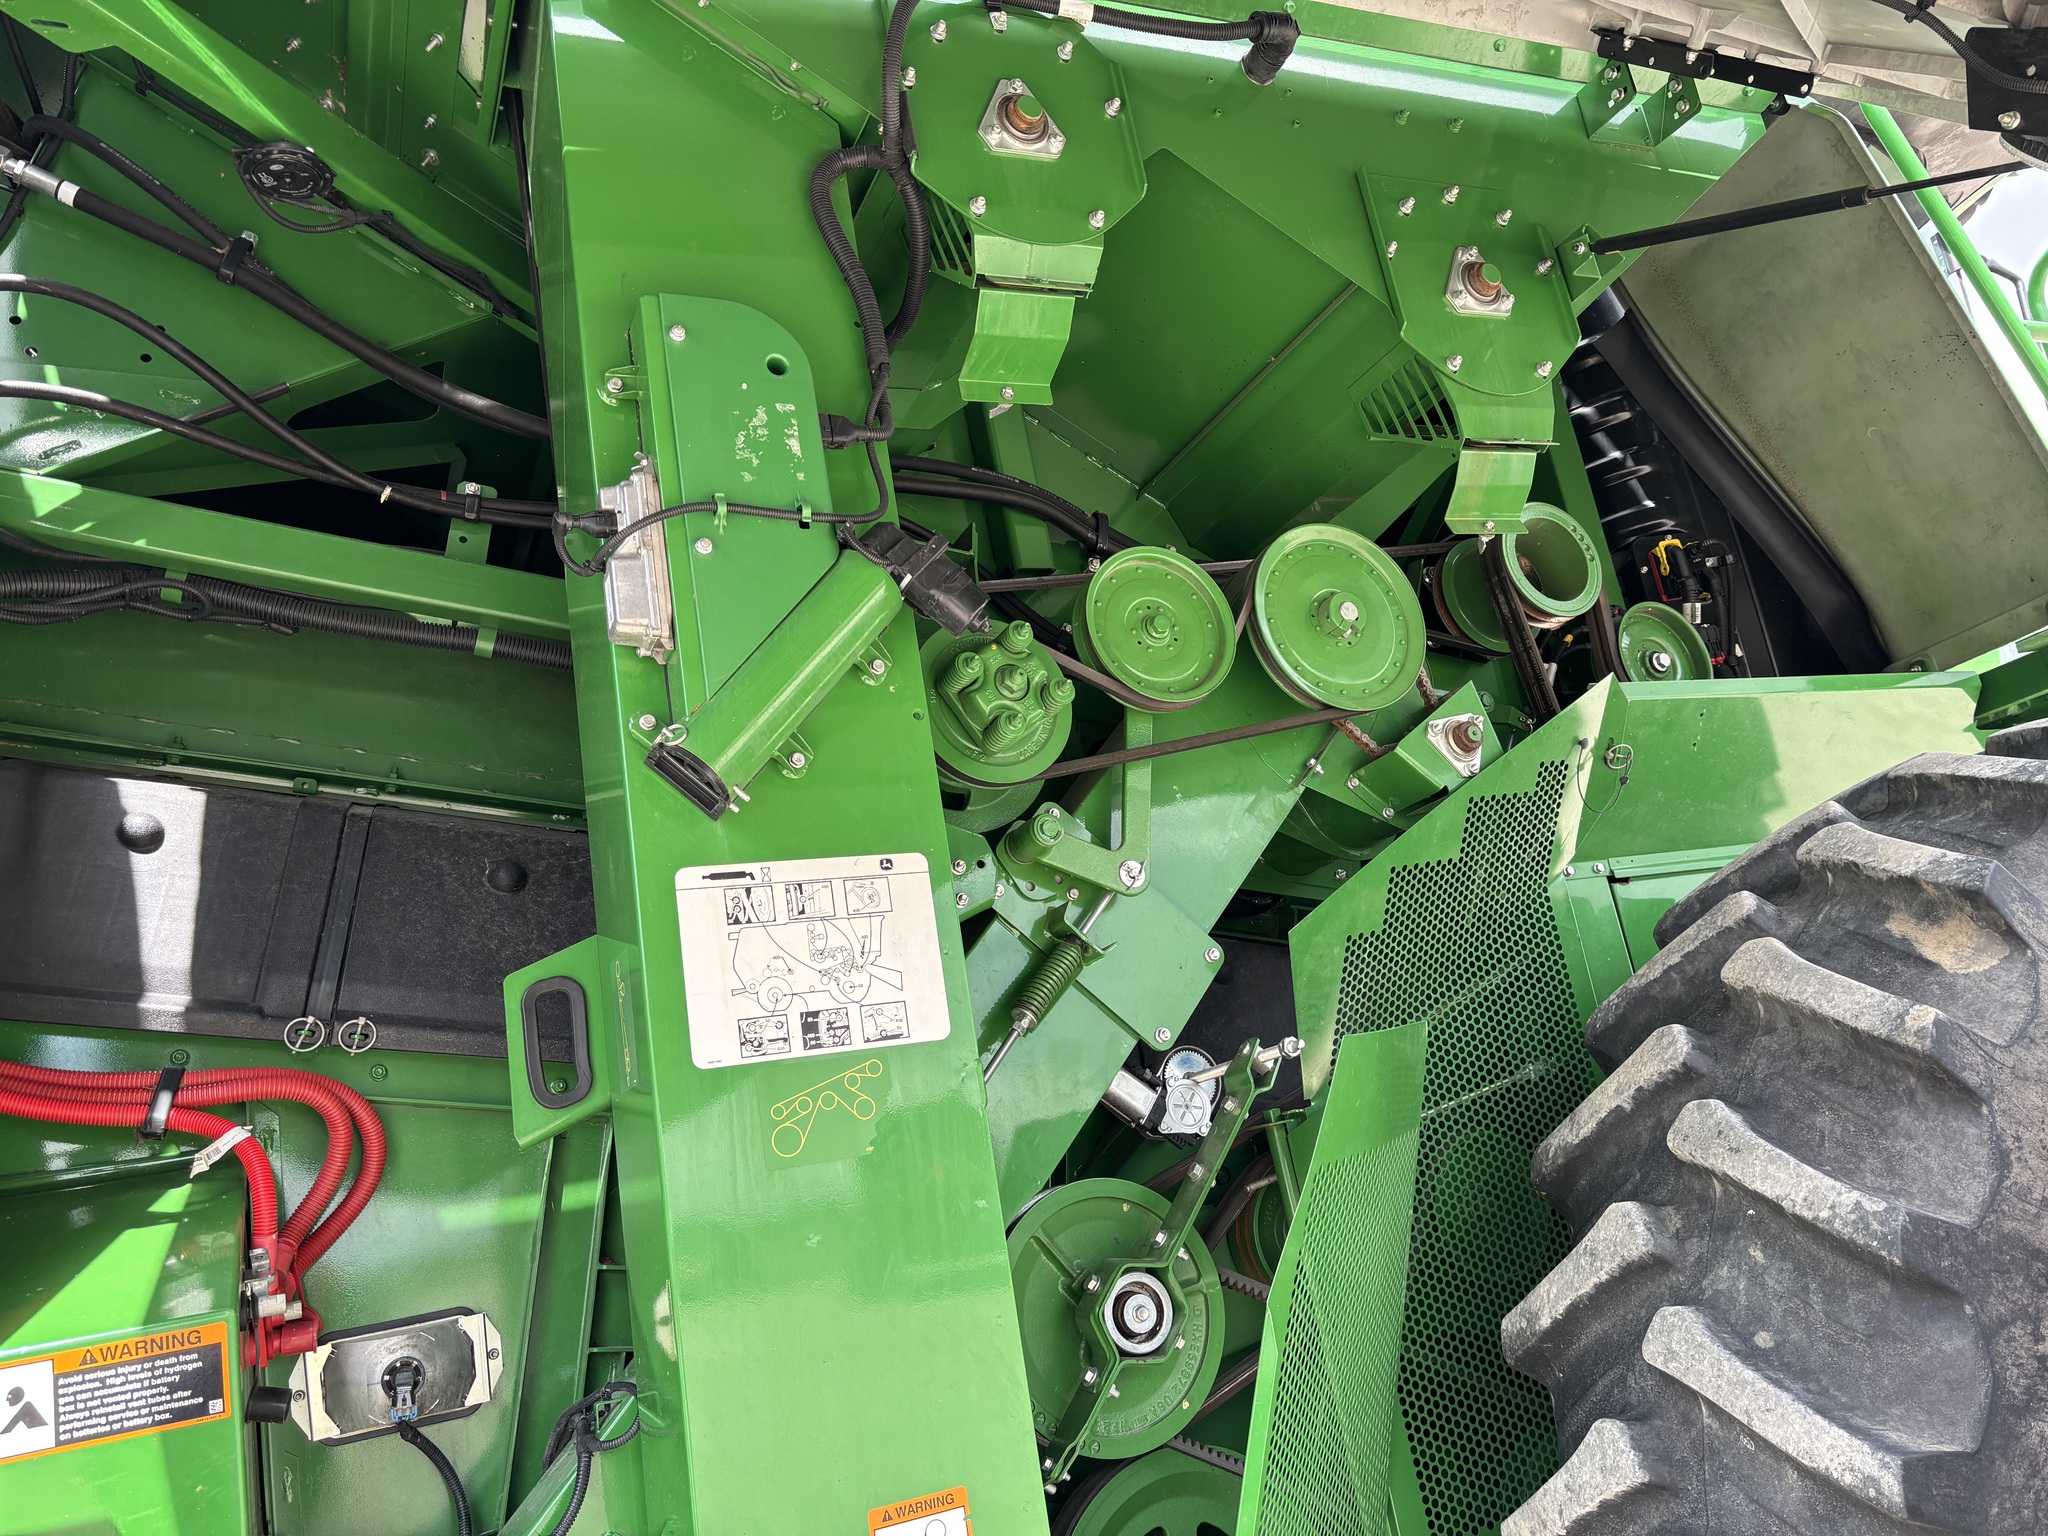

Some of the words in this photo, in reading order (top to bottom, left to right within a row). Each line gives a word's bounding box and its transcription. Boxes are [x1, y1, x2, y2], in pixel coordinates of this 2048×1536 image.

[1018, 742, 1040, 760] MADE
[99, 1330, 202, 1362] WARNING
[58, 1375, 82, 1386] Avoid
[84, 1369, 116, 1380] serious
[118, 1363, 142, 1375] injury
[154, 1357, 178, 1366] death
[179, 1352, 198, 1362] from
[58, 1381, 102, 1395] explosion.
[106, 1375, 126, 1386] High
[128, 1372, 152, 1381] levels
[154, 1368, 163, 1376] of
[164, 1362, 202, 1374] hydrogen
[58, 1396, 74, 1405] gas
[76, 1392, 92, 1401] can
[94, 1384, 142, 1397] accumulate
[151, 1374, 180, 1385] battery
[59, 1404, 75, 1413] box
[87, 1398, 101, 1407] not
[103, 1393, 131, 1404] vented
[133, 1386, 169, 1398] properly.
[59, 1411, 90, 1422] Always
[92, 1403, 126, 1416] reinstall
[128, 1400, 146, 1409] vent
[148, 1395, 170, 1404] tubes
[172, 1390, 192, 1400] after
[60, 1416, 106, 1433] performing
[108, 1411, 139, 1422] service
[151, 1397, 203, 1413] maintenance
[73, 1425, 110, 1438] batteries
[123, 1416, 153, 1428] battery
[155, 1412, 172, 1421] box.
[895, 1494, 955, 1518] WARNING
